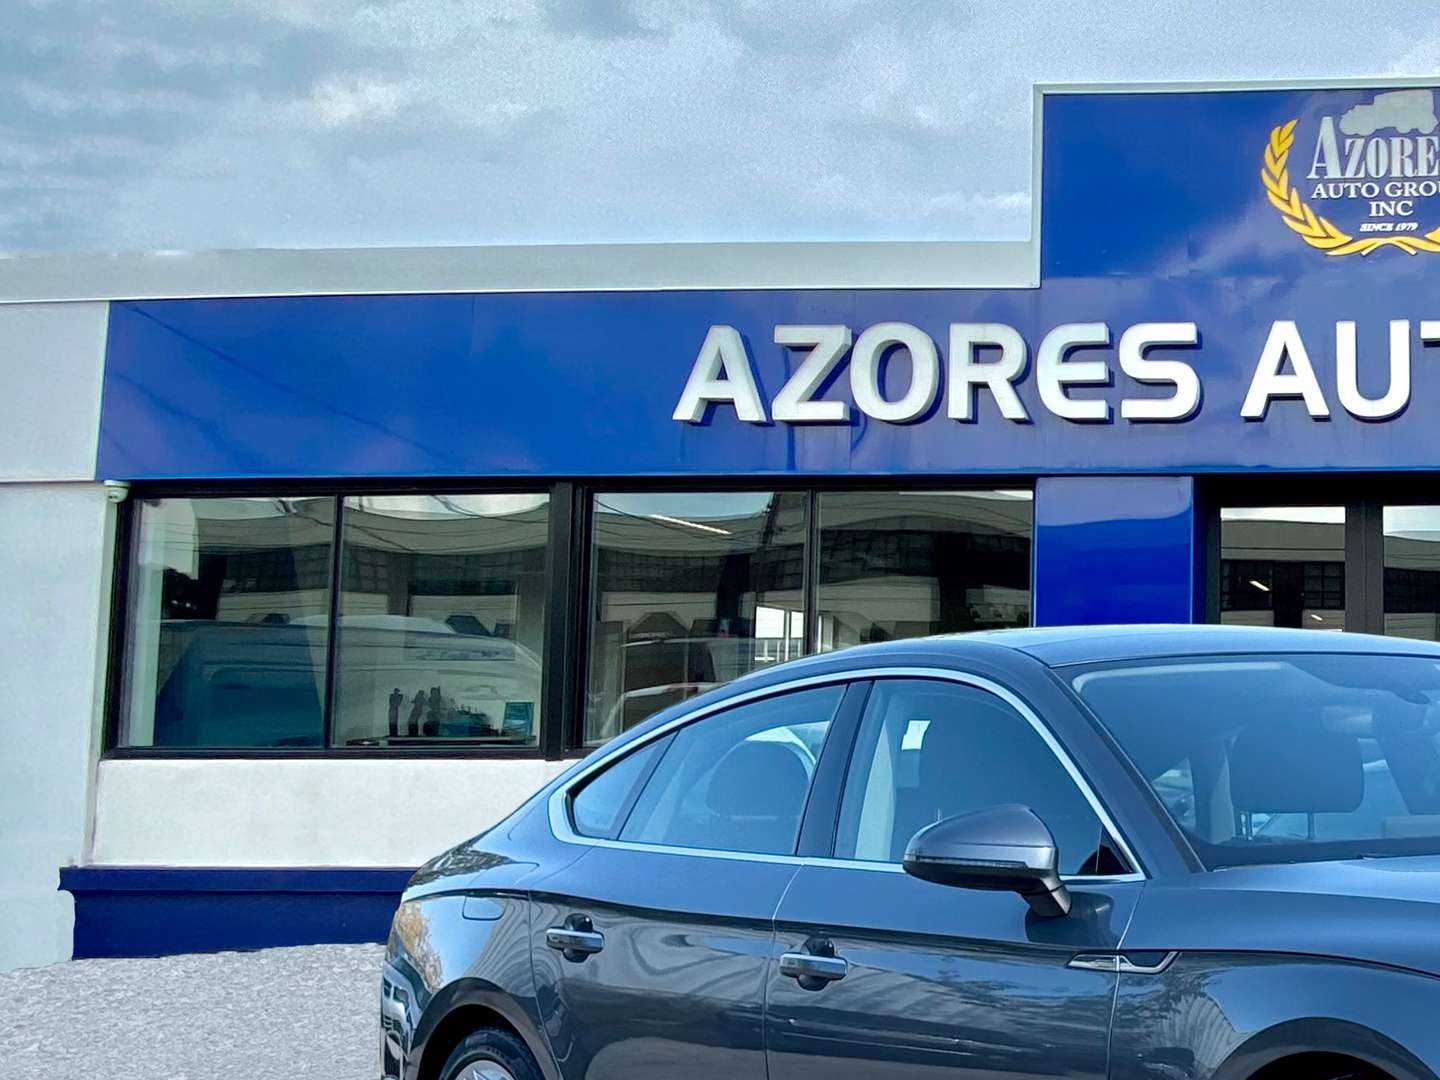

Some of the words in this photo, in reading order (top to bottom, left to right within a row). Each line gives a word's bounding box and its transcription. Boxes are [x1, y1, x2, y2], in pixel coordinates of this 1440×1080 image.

[1311, 182, 1382, 200] AUTO
[1369, 200, 1413, 217] INC
[1360, 223, 1394, 232] SINCE
[672, 321, 1200, 424] AZORES
